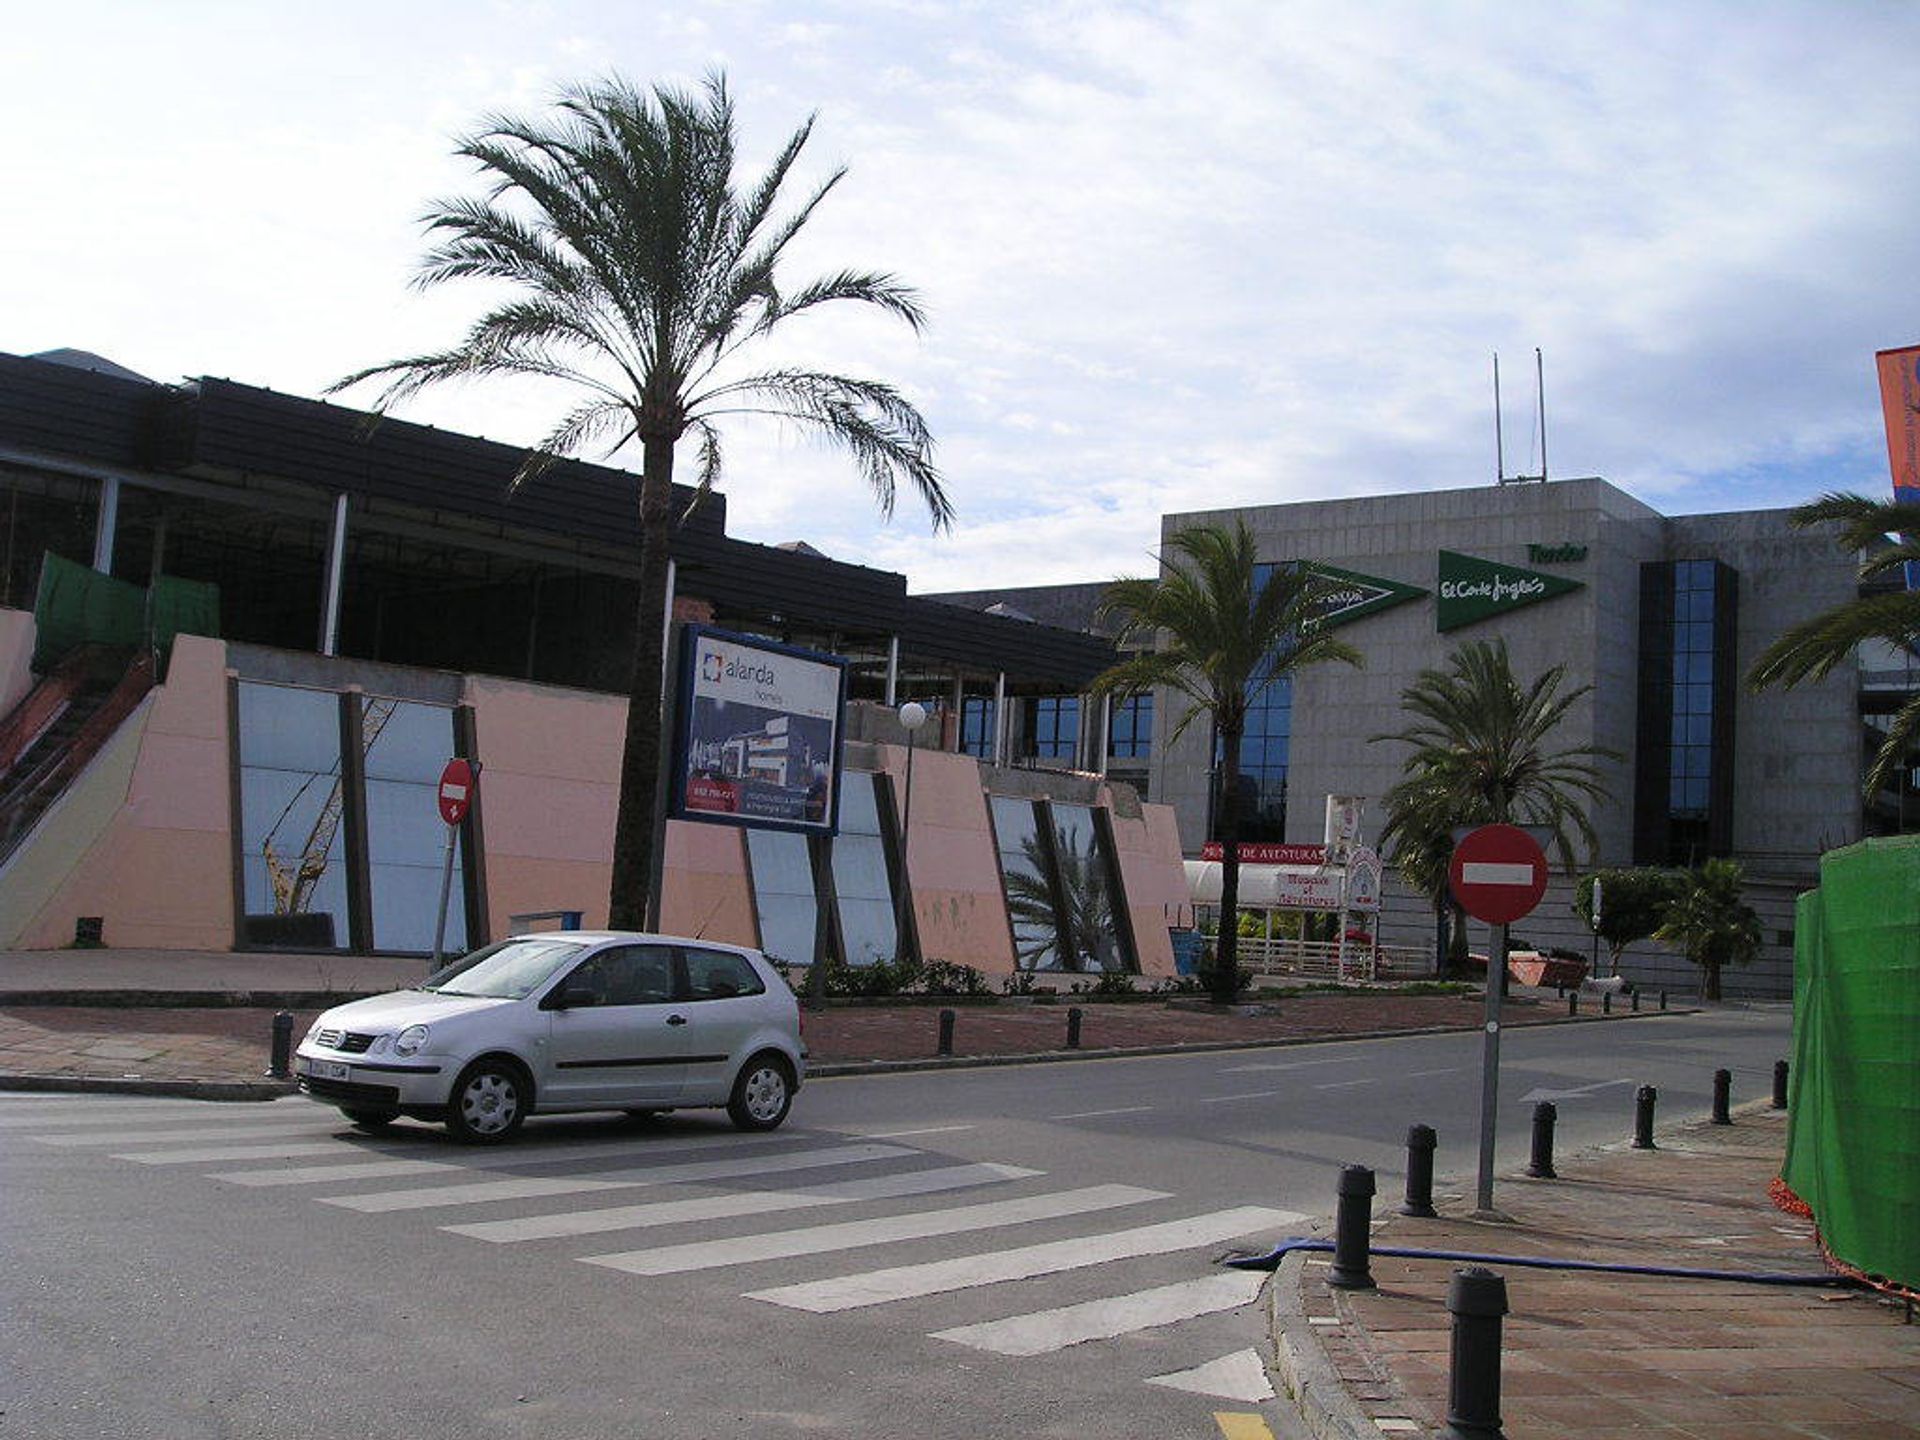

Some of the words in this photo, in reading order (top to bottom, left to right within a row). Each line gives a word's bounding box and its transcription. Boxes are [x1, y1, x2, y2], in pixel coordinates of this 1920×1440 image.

[1441, 581, 1456, 598] El
[1457, 581, 1491, 598] Corte
[1492, 574, 1545, 601] Inglés
[1242, 849, 1257, 859] DE
